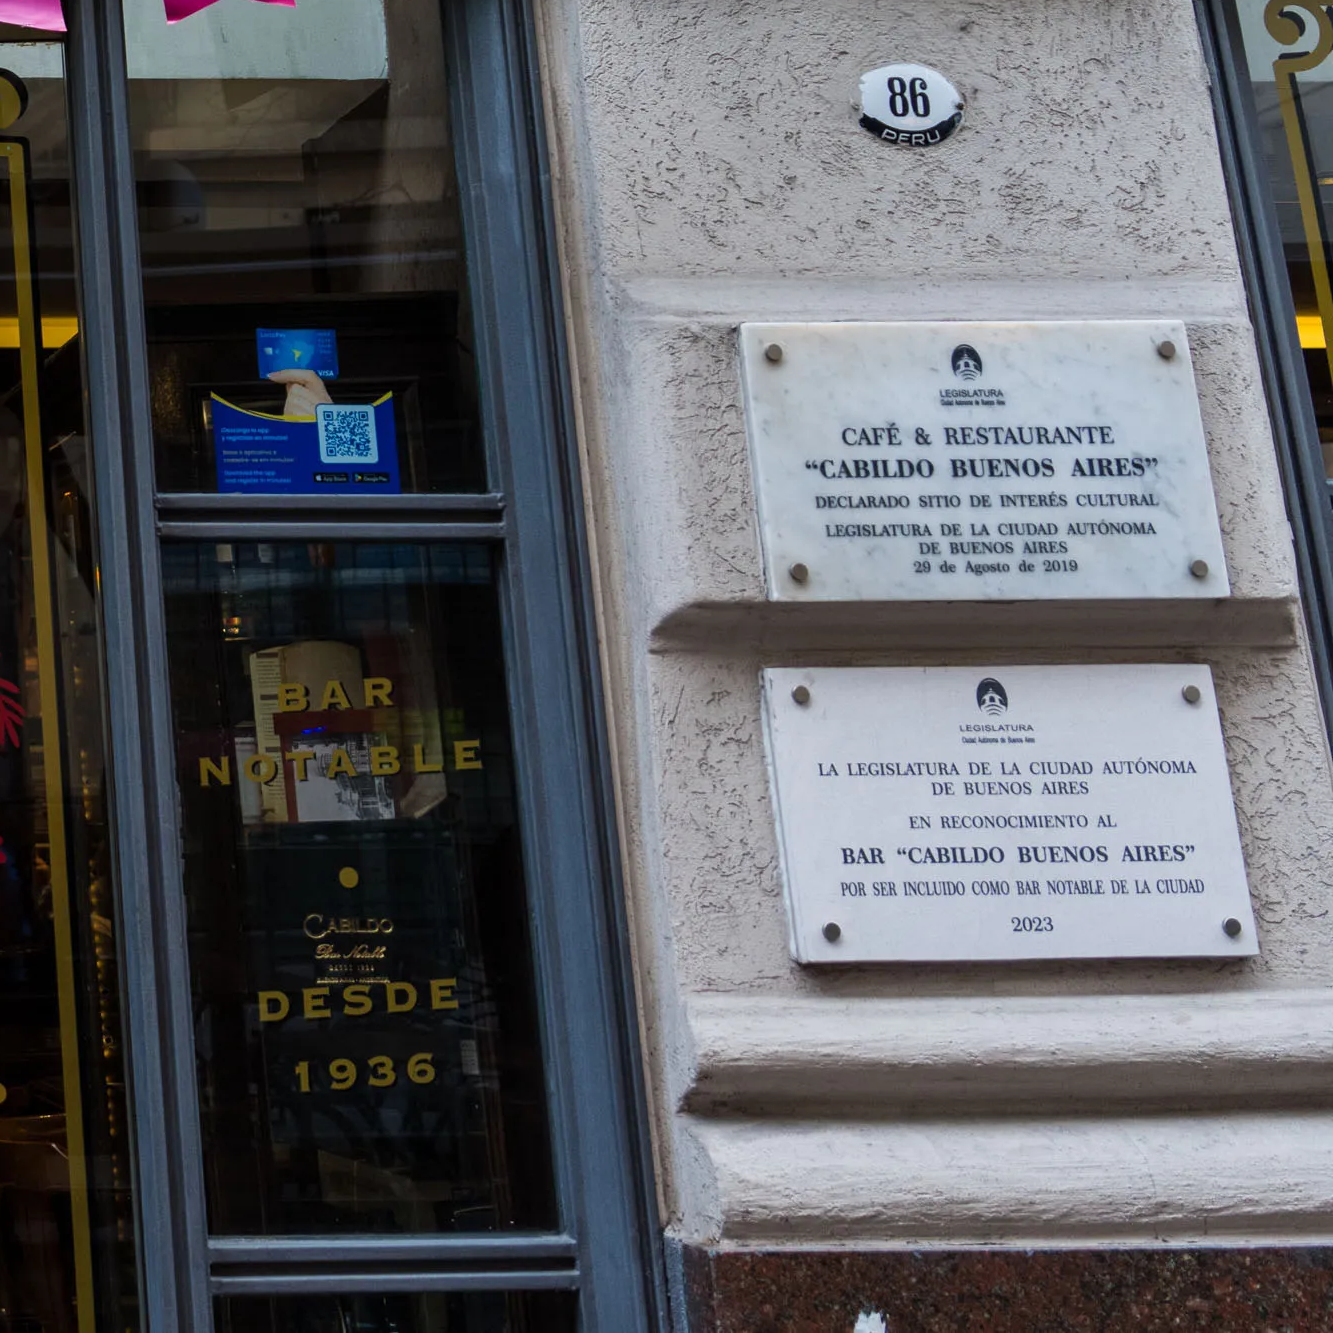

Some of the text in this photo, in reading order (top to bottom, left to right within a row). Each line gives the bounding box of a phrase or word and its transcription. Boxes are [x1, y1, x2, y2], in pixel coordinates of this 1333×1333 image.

[887, 77, 930, 117] 86
[881, 128, 940, 144] PERU
[939, 389, 1004, 399] LEGISLATURA
[841, 423, 1115, 447] CAFÉ & RESTAURANTE
[951, 458, 1055, 477] BUENOS
[815, 491, 1159, 509] DECLARADO SITIO DE INTERÉS CULTURAL
[914, 560, 1078, 576] 29 de Agosto de 2019
[277, 677, 394, 713] BAR
[959, 724, 1034, 732] LEGISLATURA
[199, 739, 483, 787] NOTABLE
[818, 757, 1197, 776] LA LEGISLATURA DE LA CIUDAD AUTÓNOMA
[932, 781, 1089, 796] DE BUENOS AIRES
[908, 815, 1117, 830] EN RECONOCIMIENTO AL
[841, 848, 885, 865] BAR
[1018, 846, 1108, 864] BUENOS
[303, 914, 394, 938] CABILDO
[1011, 917, 1054, 933] 2023
[258, 978, 459, 1022] DESDE
[295, 1052, 435, 1093] 1936
